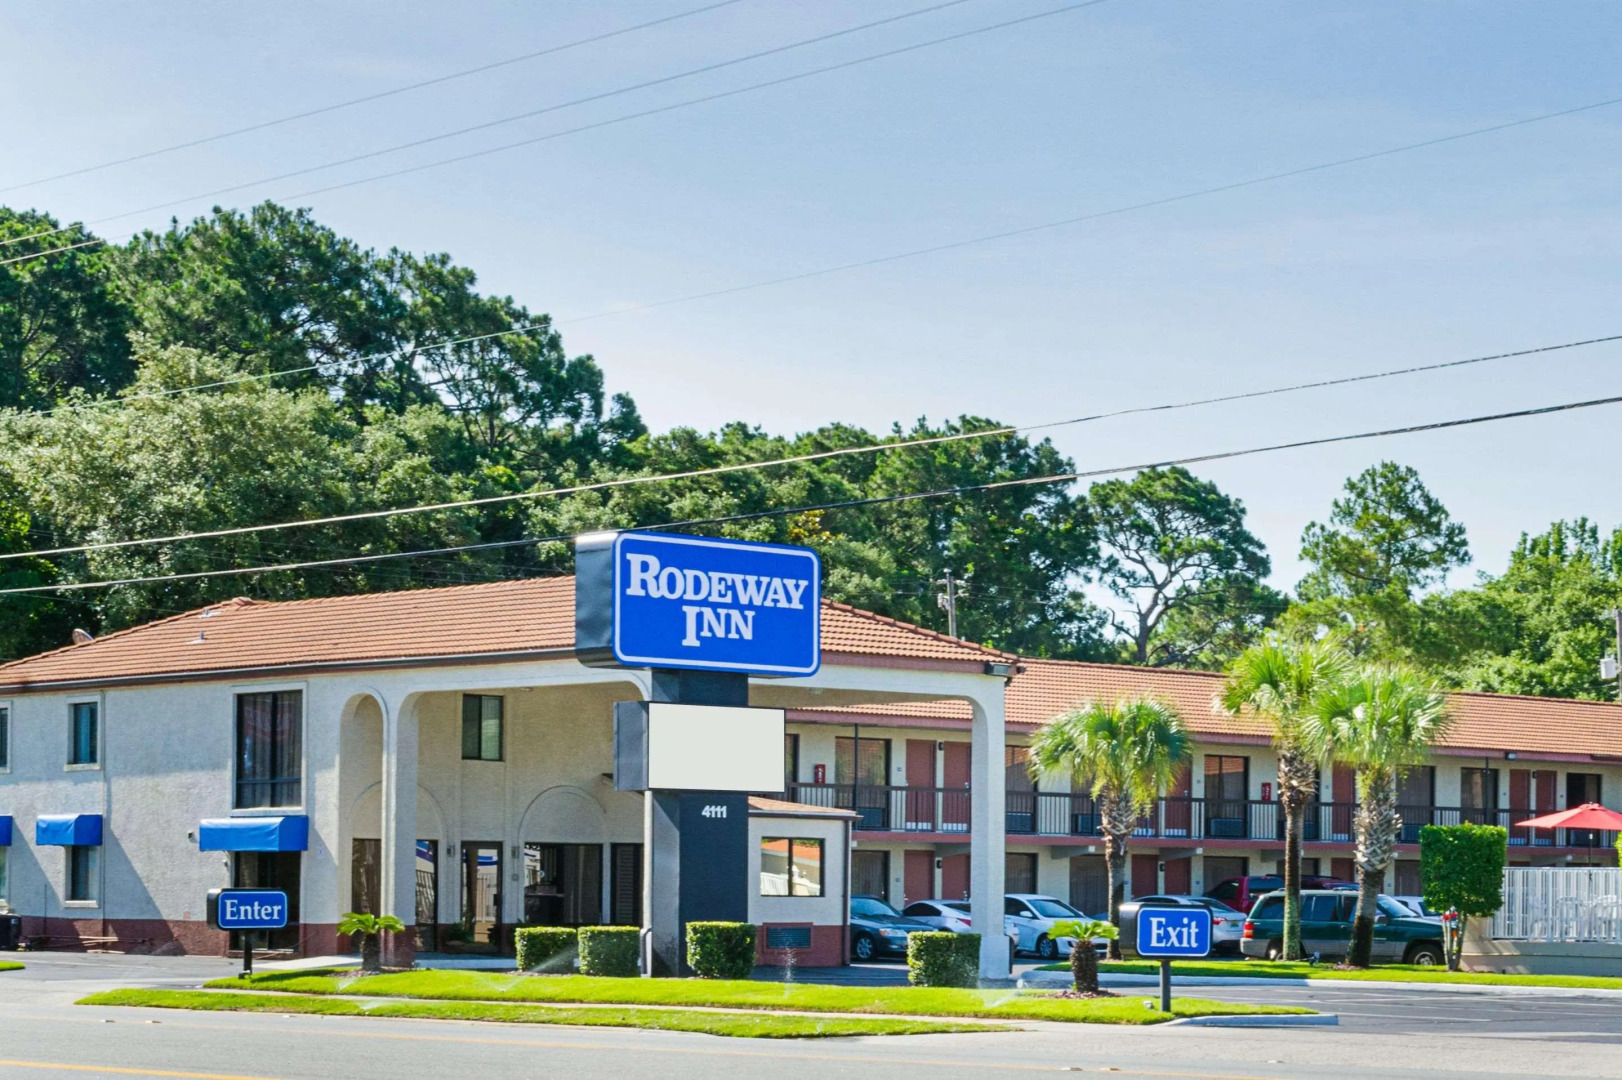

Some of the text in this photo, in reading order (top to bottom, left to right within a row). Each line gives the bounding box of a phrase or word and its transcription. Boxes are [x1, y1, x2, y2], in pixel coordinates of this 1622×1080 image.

[626, 553, 808, 609] RODEWAY
[682, 605, 755, 647] INN
[701, 805, 727, 818] 4111
[224, 899, 282, 920] Enter
[1149, 917, 1199, 948] Exit
